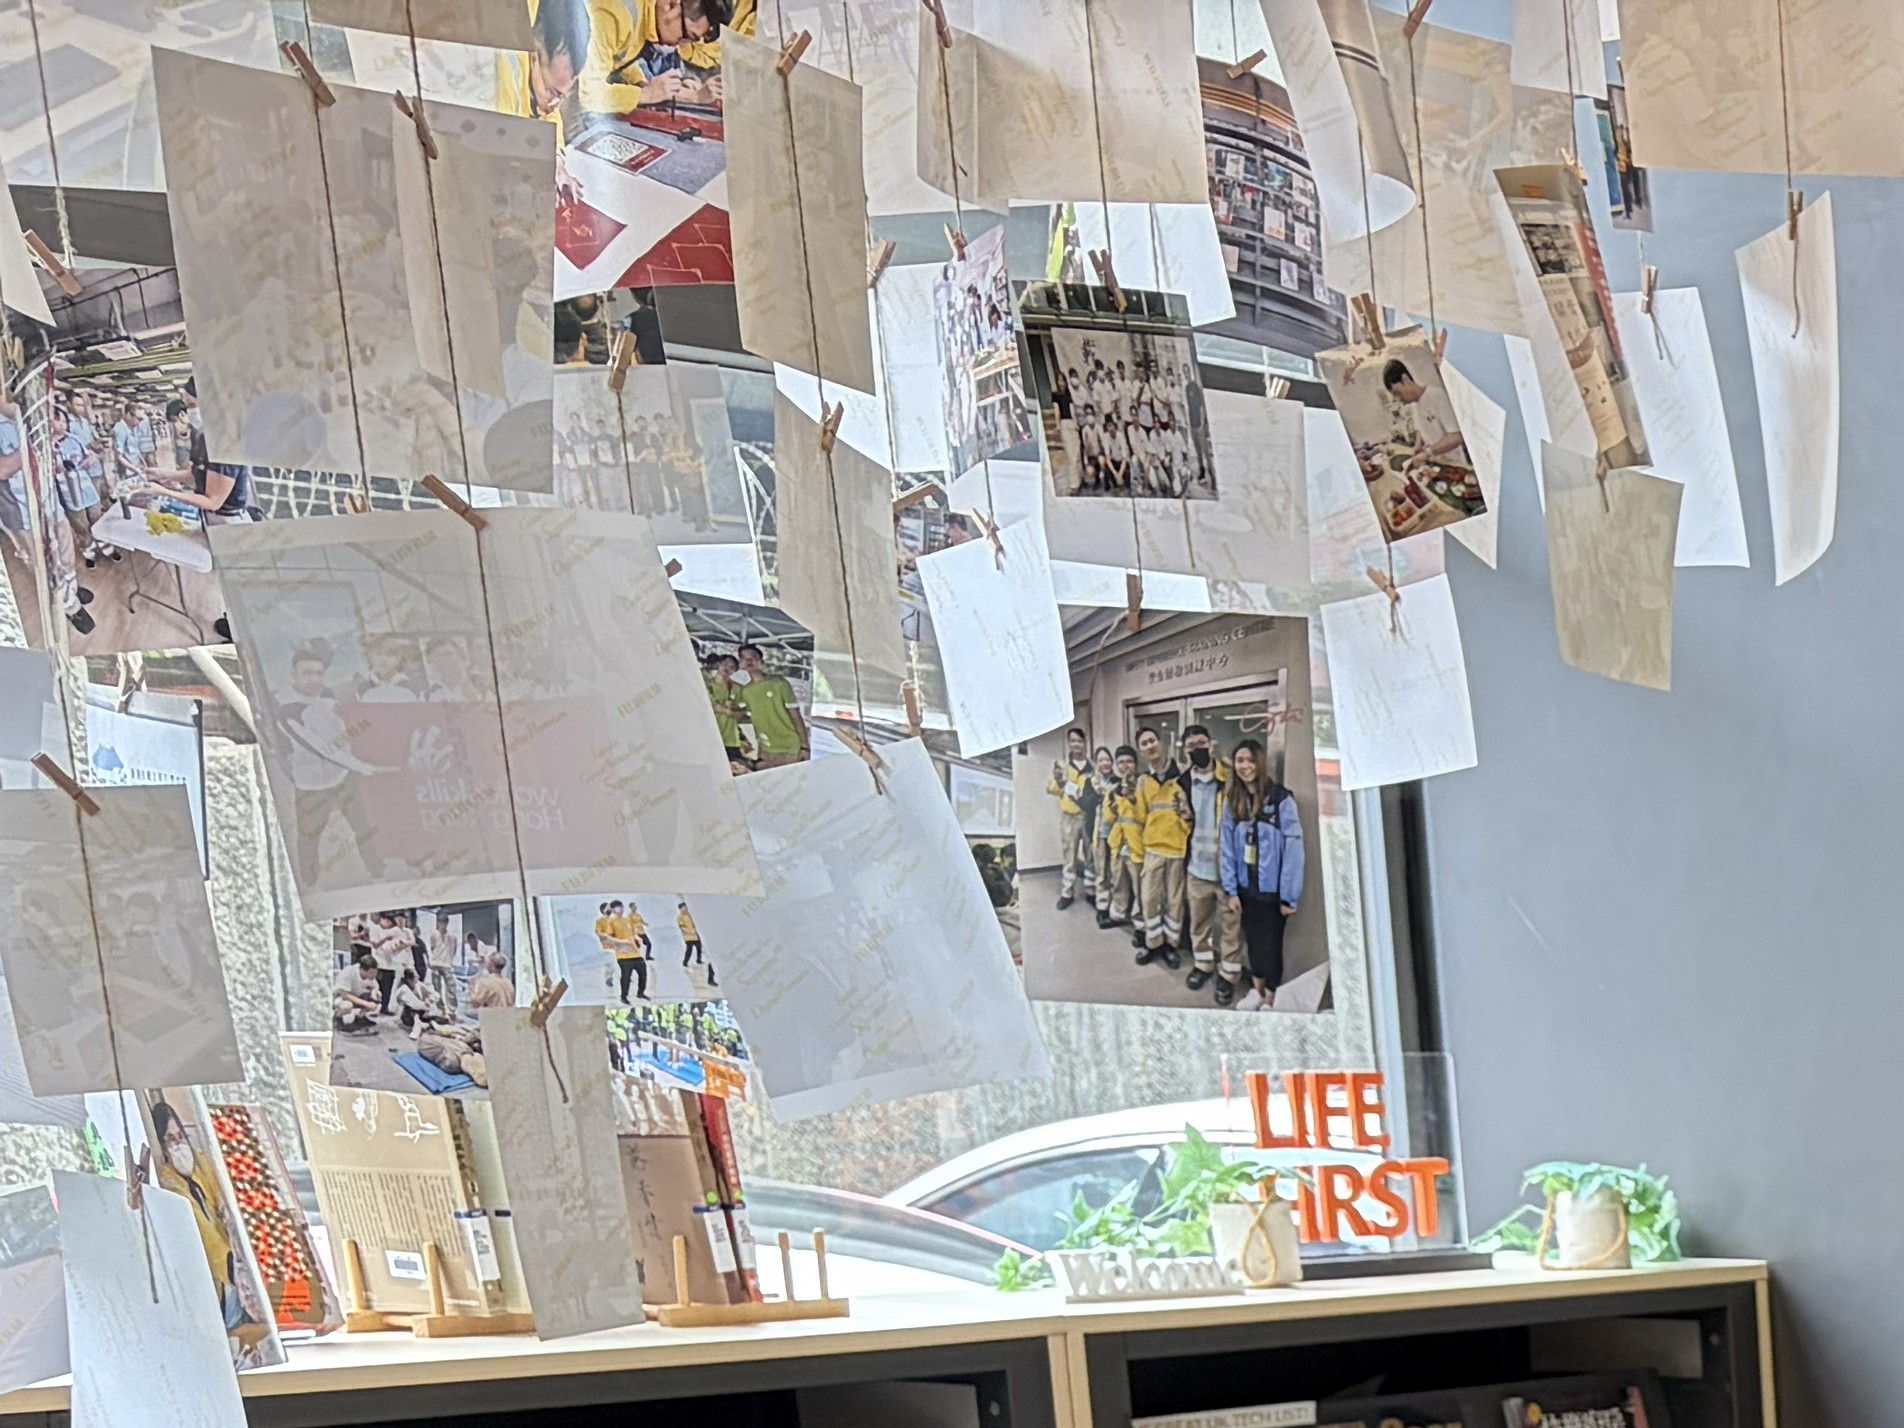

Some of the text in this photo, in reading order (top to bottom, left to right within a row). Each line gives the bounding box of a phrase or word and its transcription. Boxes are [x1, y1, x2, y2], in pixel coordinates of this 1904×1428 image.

[1245, 1071, 1390, 1150] LIFE
[1257, 1157, 1449, 1243] IRST
[1058, 1253, 1243, 1296] Welcome
